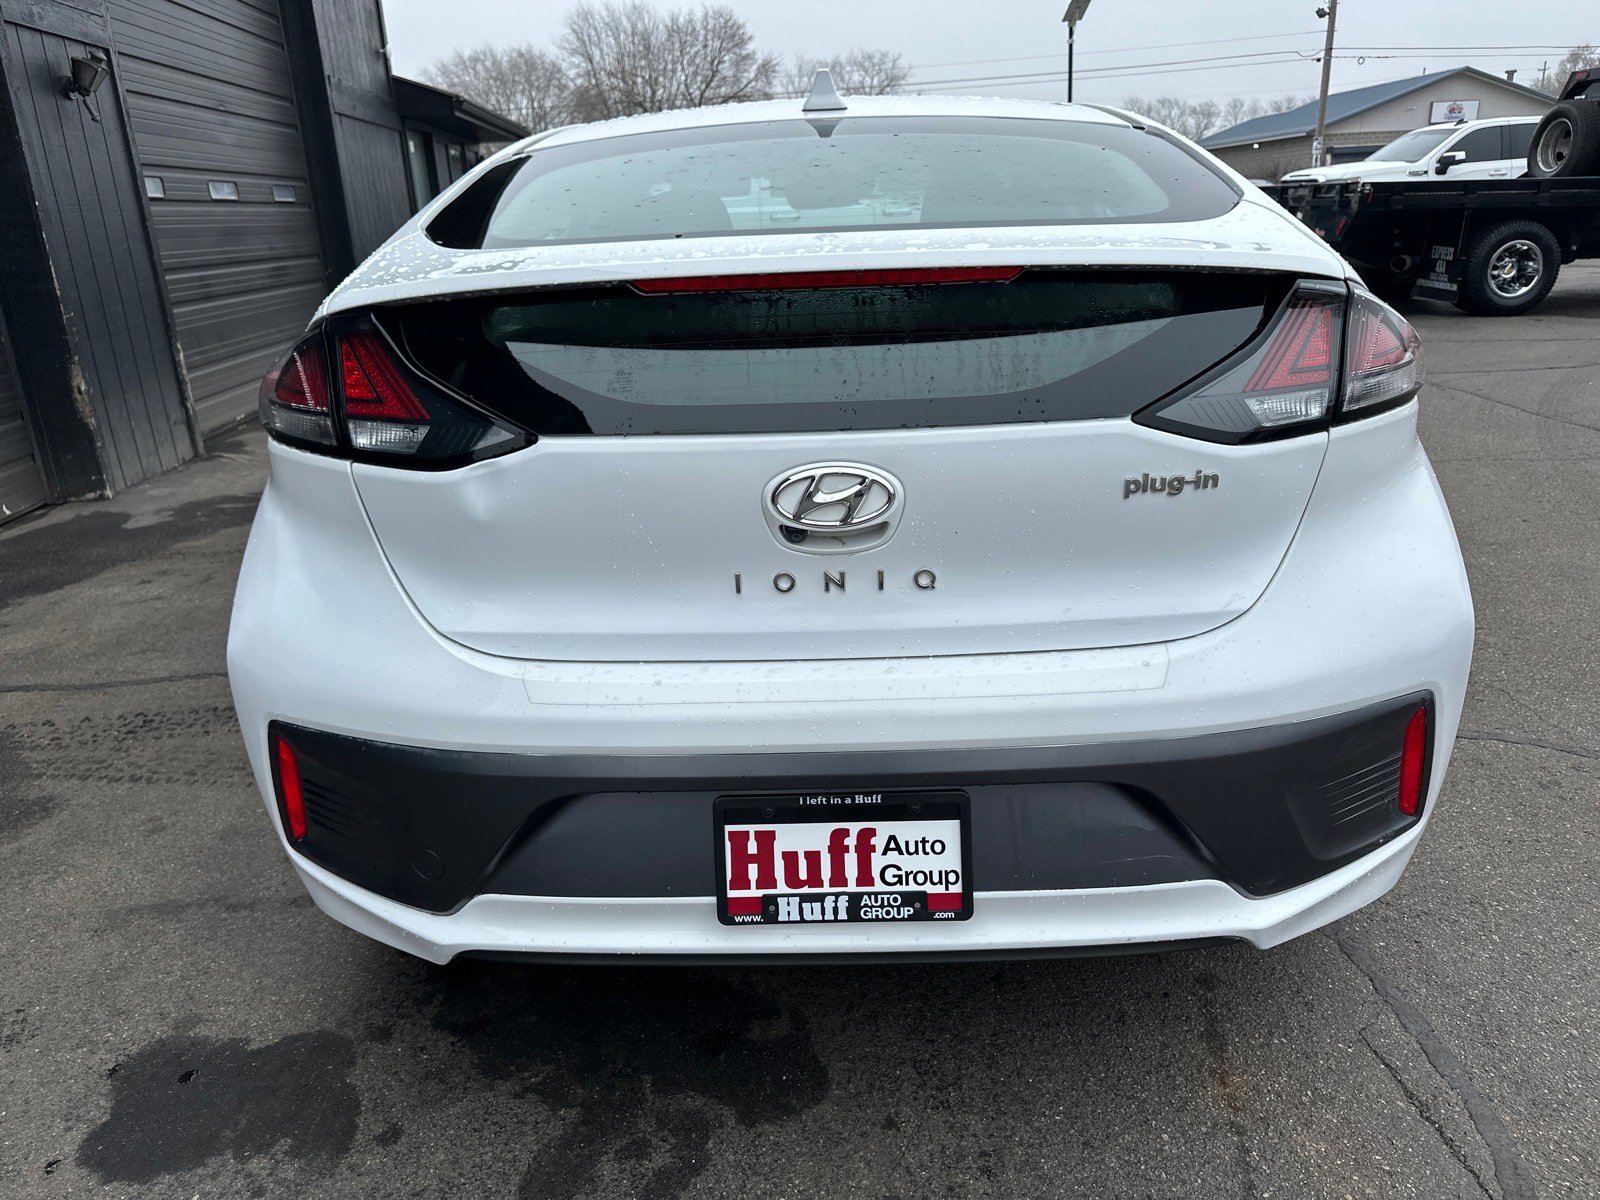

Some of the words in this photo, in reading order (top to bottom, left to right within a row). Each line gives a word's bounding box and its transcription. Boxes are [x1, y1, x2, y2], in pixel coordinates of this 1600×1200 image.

[1123, 469, 1219, 499] plug-in
[734, 567, 937, 594] IONIQ
[799, 796, 803, 805] I
[806, 795, 827, 805] left
[830, 795, 842, 804] in
[855, 794, 882, 804] Huff
[881, 834, 946, 856] Auto
[727, 827, 877, 891] Huff
[879, 863, 960, 891] Group
[734, 914, 764, 923] www.
[777, 895, 849, 922] Huff
[860, 906, 914, 919] GROUP
[933, 911, 955, 919] .com
[860, 894, 902, 907] AUTO
